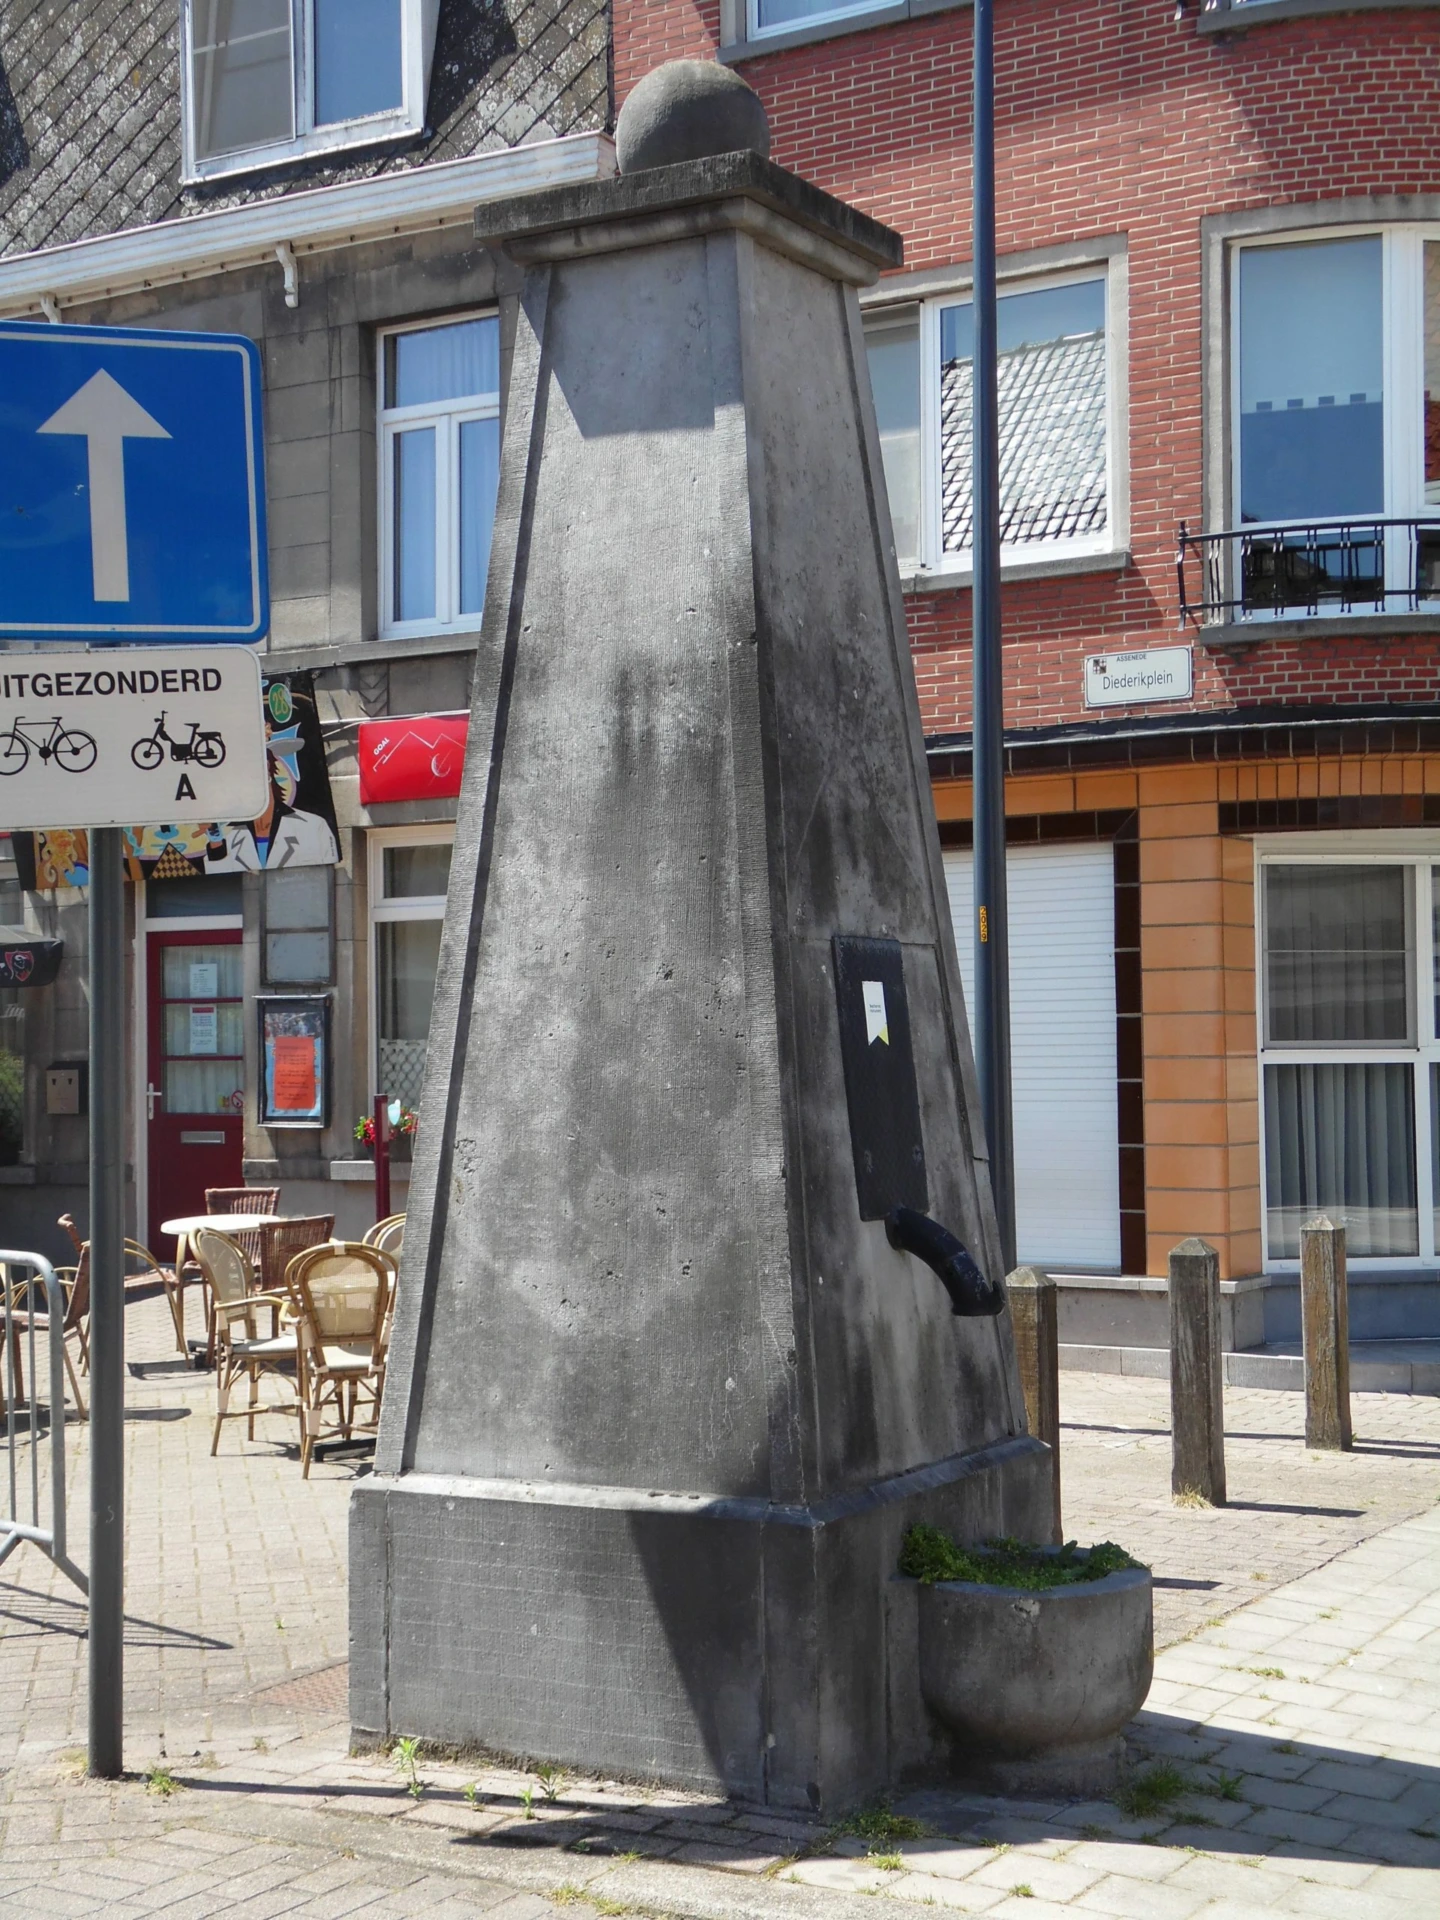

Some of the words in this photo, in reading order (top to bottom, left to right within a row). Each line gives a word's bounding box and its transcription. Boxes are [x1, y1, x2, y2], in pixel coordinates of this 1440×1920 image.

[1116, 653, 1147, 662] ASSENEDE
[0, 668, 222, 698] ITGEZONDERD
[1102, 670, 1173, 690] Diederikplein
[373, 737, 390, 756] GOAL
[175, 773, 197, 801] A
